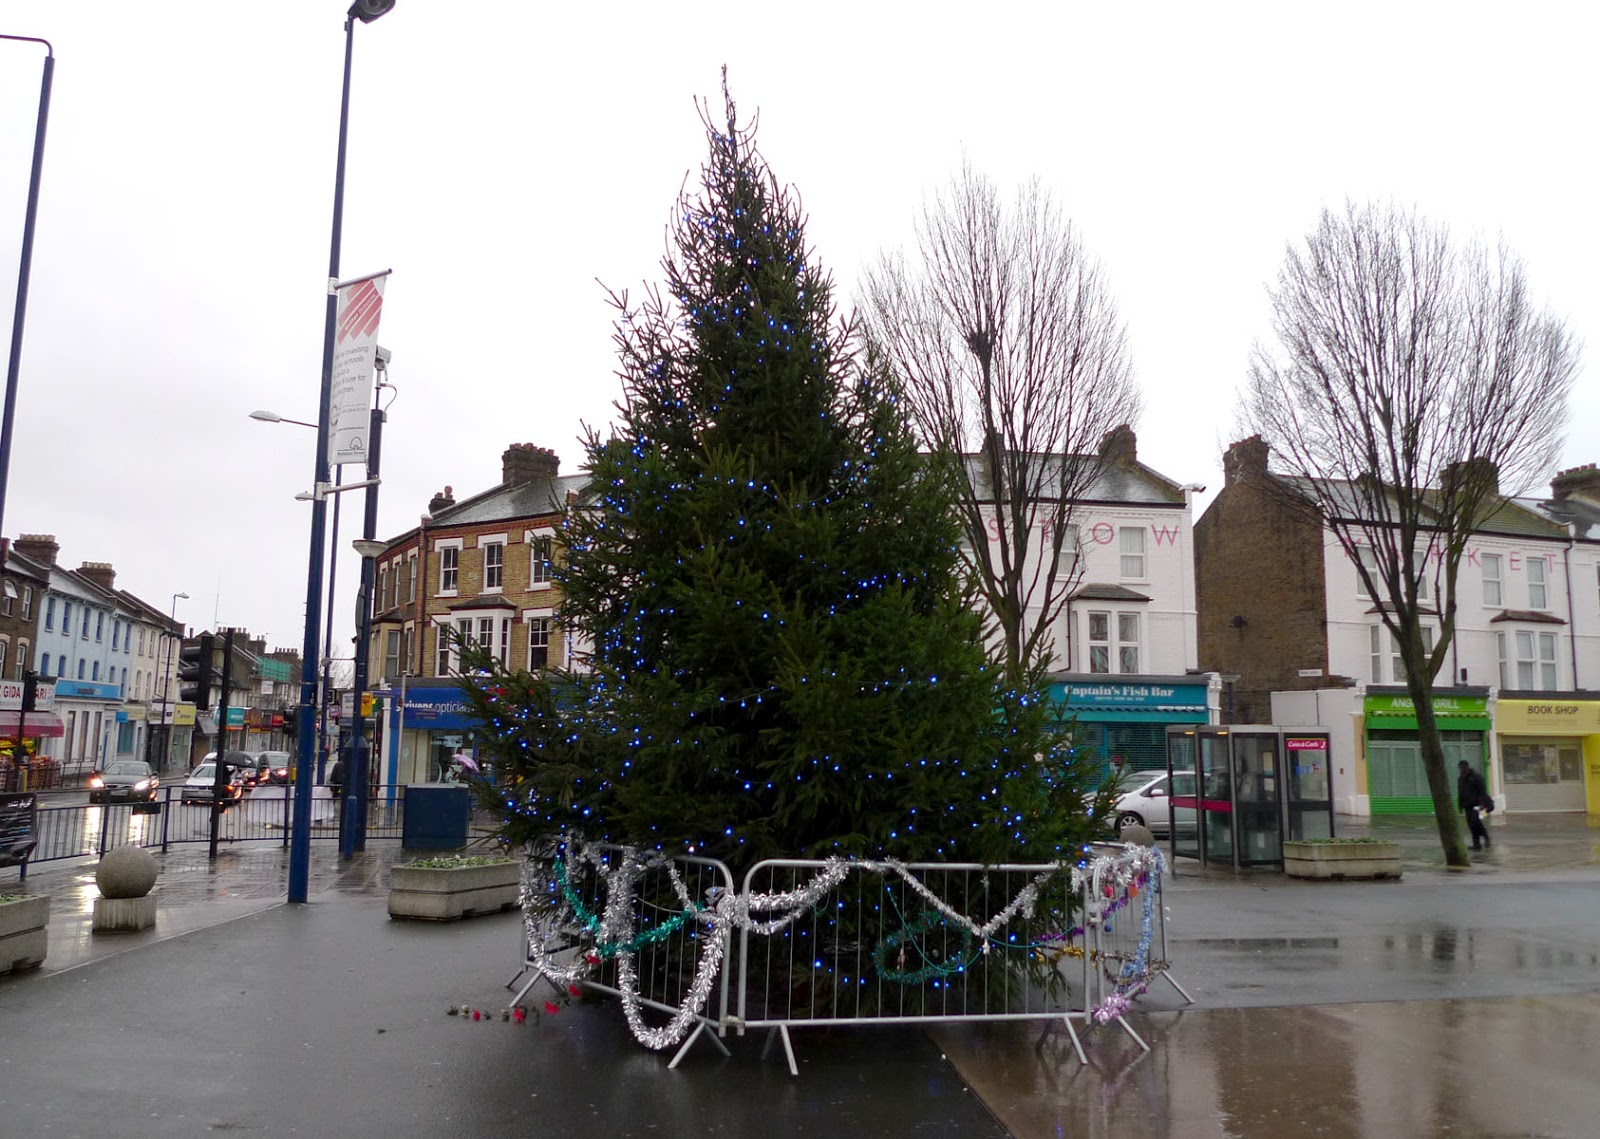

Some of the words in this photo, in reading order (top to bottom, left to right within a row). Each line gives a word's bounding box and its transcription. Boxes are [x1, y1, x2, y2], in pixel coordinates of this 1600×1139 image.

[3, 685, 21, 699] GIDA
[1064, 684, 1121, 697] Captain's
[1122, 685, 1148, 697] Fish
[1151, 686, 1174, 697] Bar
[1433, 699, 1459, 709] GRILL
[1527, 705, 1553, 715] BOOK
[1554, 705, 1579, 715] SHOP
